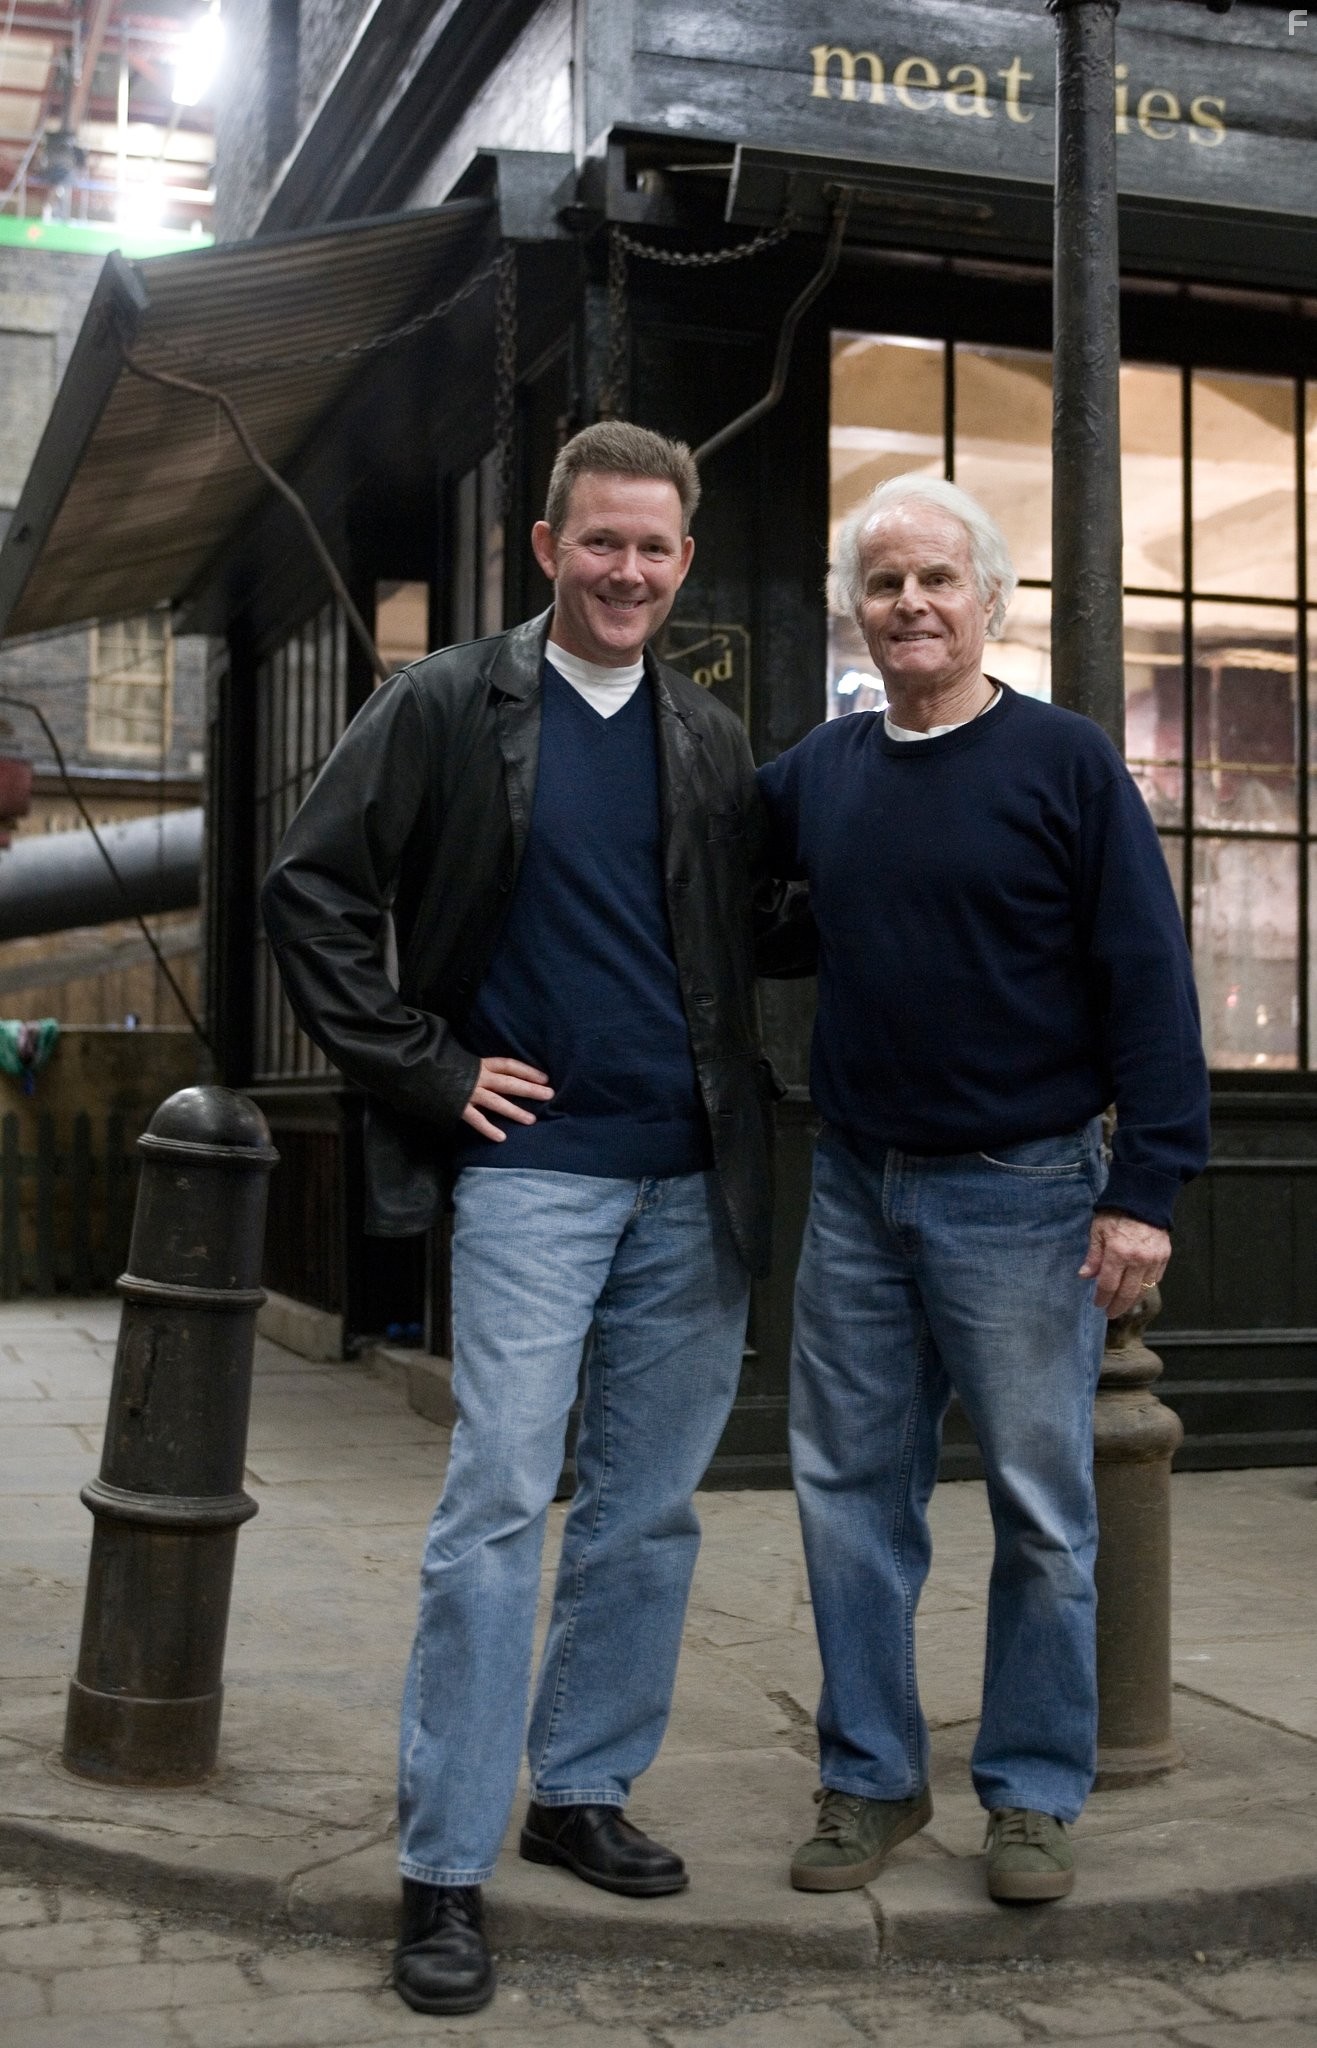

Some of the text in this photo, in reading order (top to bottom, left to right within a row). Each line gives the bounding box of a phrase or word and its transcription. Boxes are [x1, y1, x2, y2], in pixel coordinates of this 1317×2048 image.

[808, 43, 1227, 148] meat ies
[692, 648, 733, 689] od
